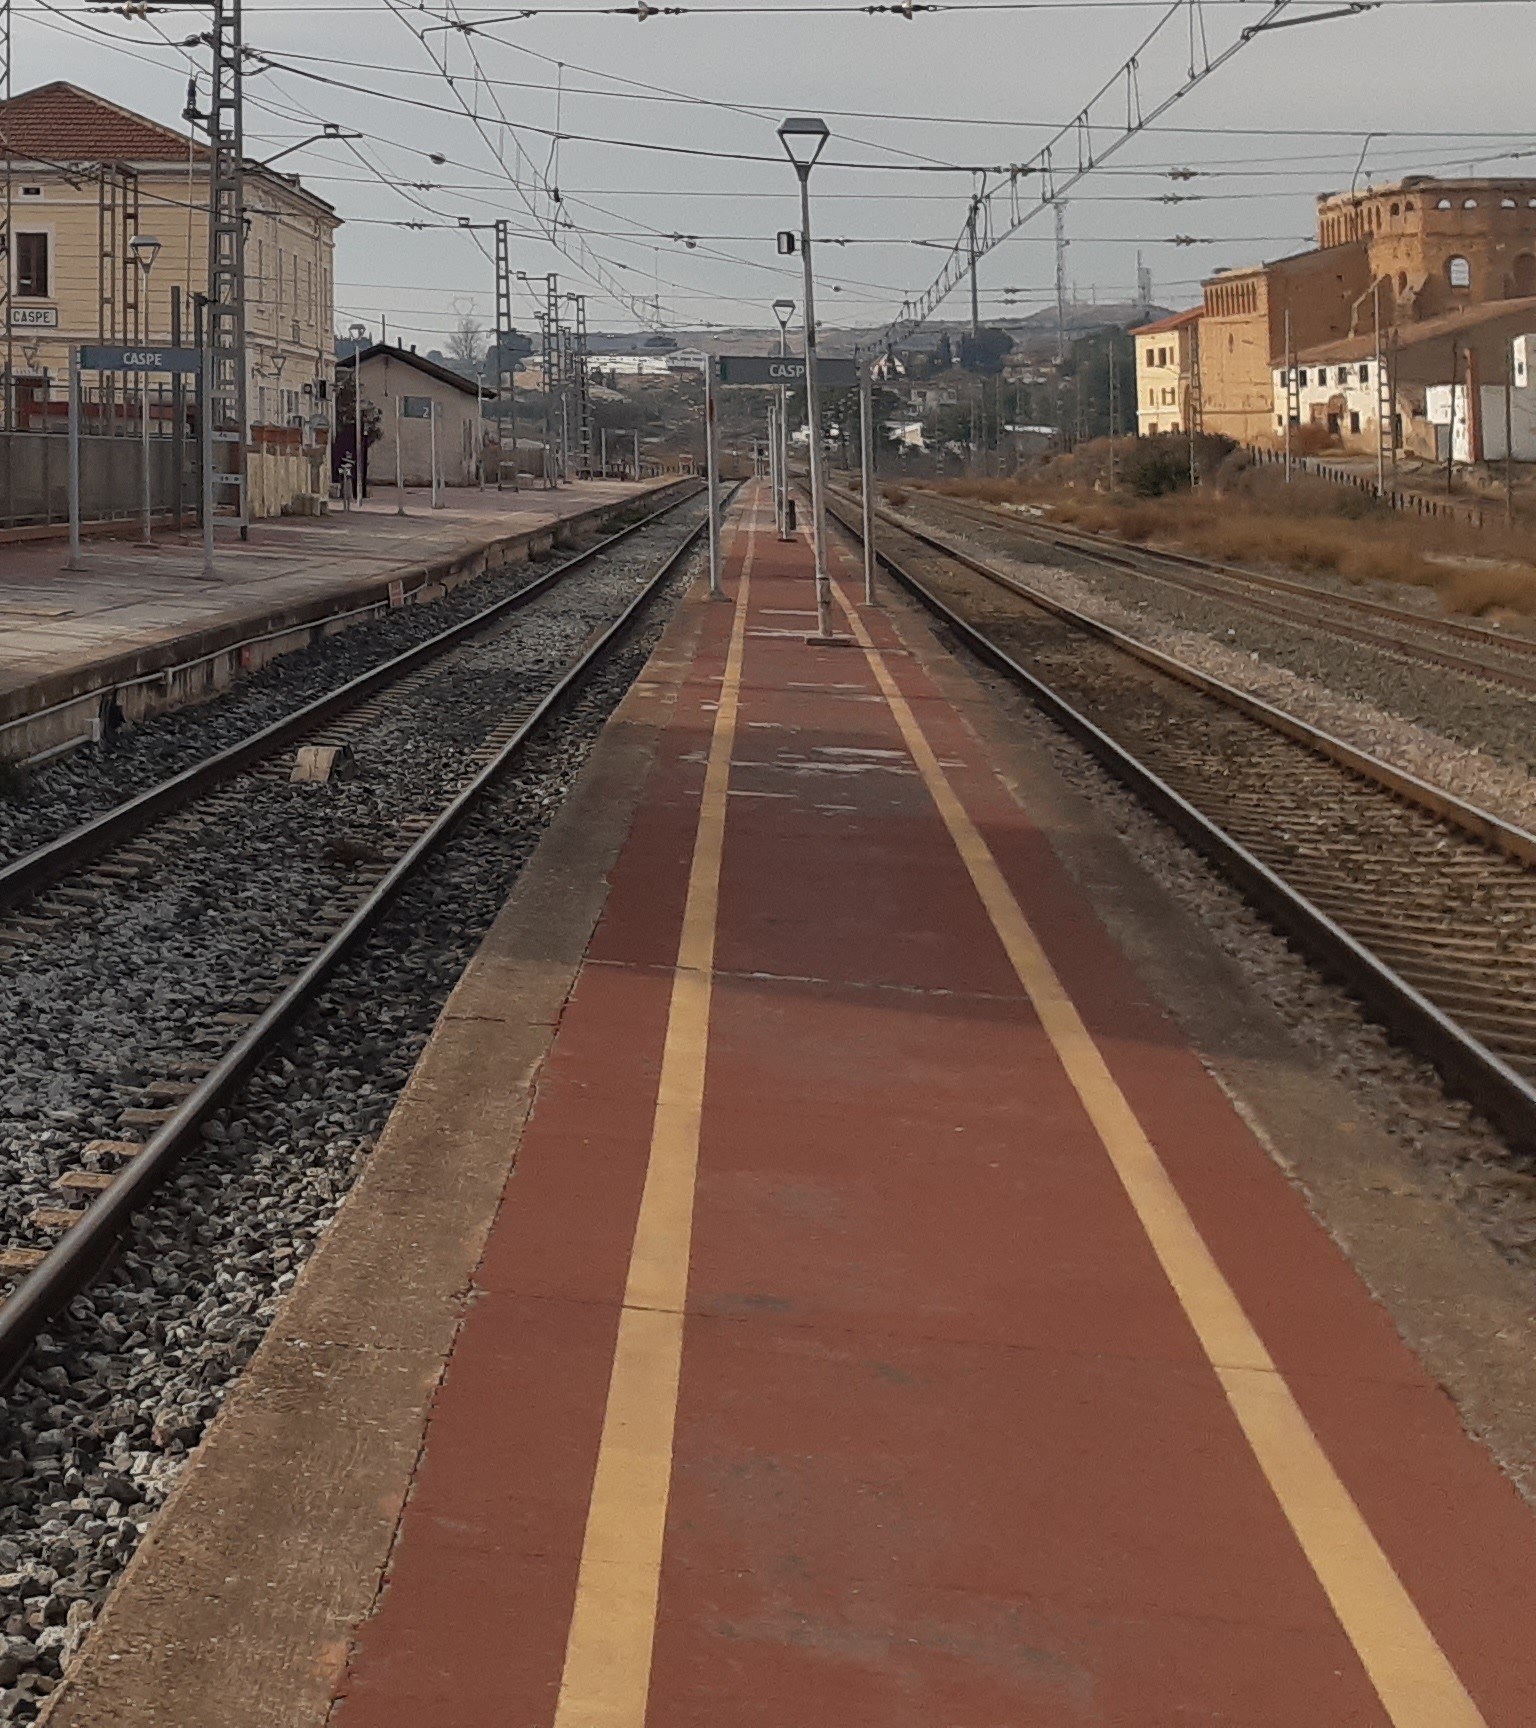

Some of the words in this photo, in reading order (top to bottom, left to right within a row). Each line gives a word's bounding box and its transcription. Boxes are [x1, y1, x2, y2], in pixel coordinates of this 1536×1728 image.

[13, 311, 51, 323] CASPE
[123, 352, 163, 366] CASPE
[769, 364, 805, 378] CASP
[422, 406, 430, 418] 2
